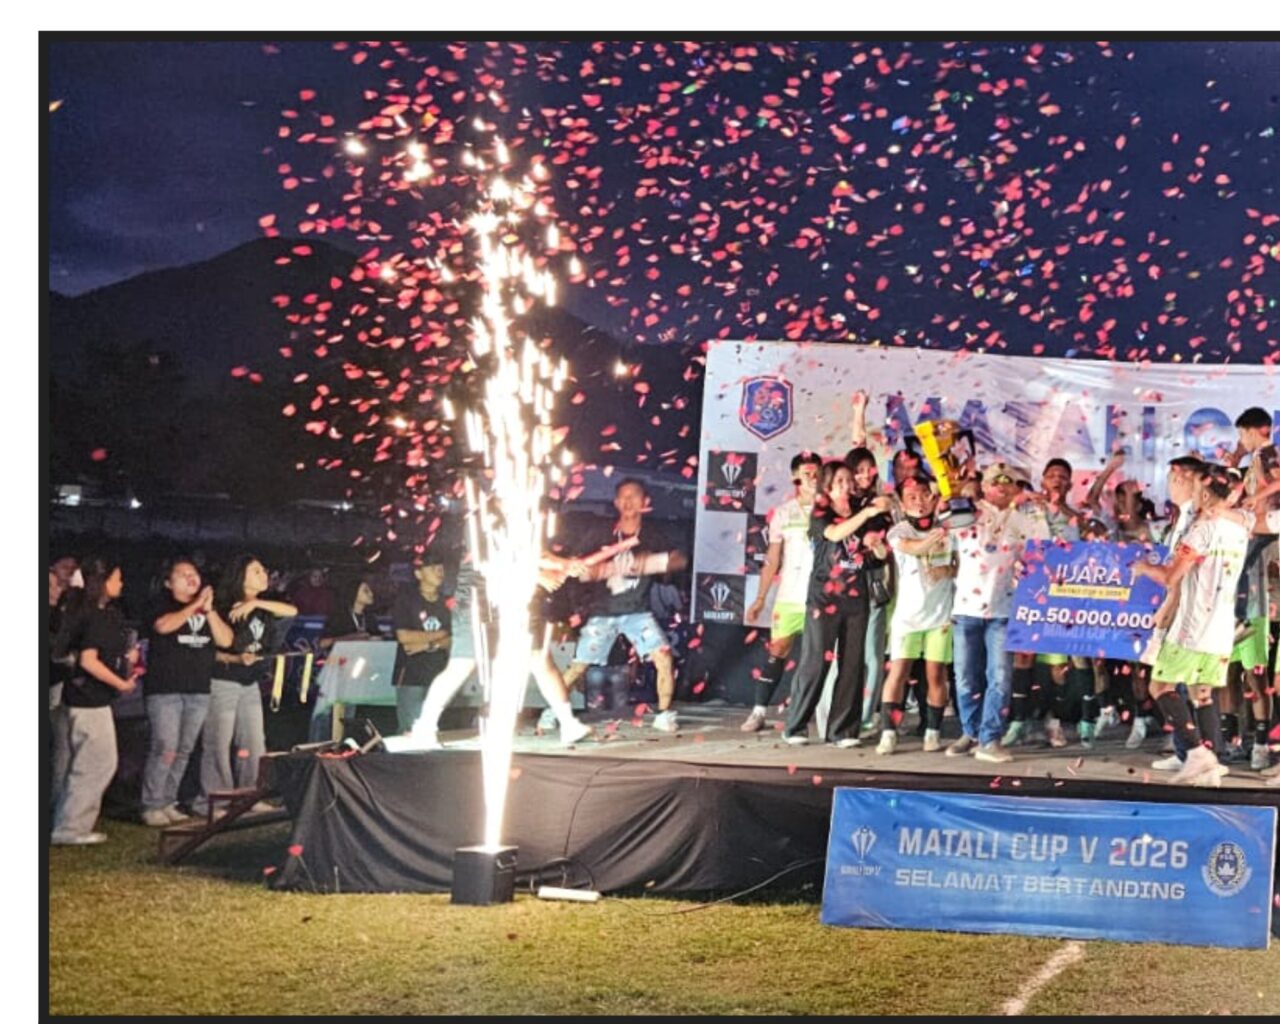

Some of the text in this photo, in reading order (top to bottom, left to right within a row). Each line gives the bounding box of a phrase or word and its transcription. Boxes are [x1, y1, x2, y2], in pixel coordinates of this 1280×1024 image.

[1015, 605, 1152, 630] Rp.50.000.000
[898, 827, 1189, 869] MATALI CUP V 2026
[894, 868, 1018, 891] SELAMAT
[1022, 875, 1186, 900] BERTANDING
